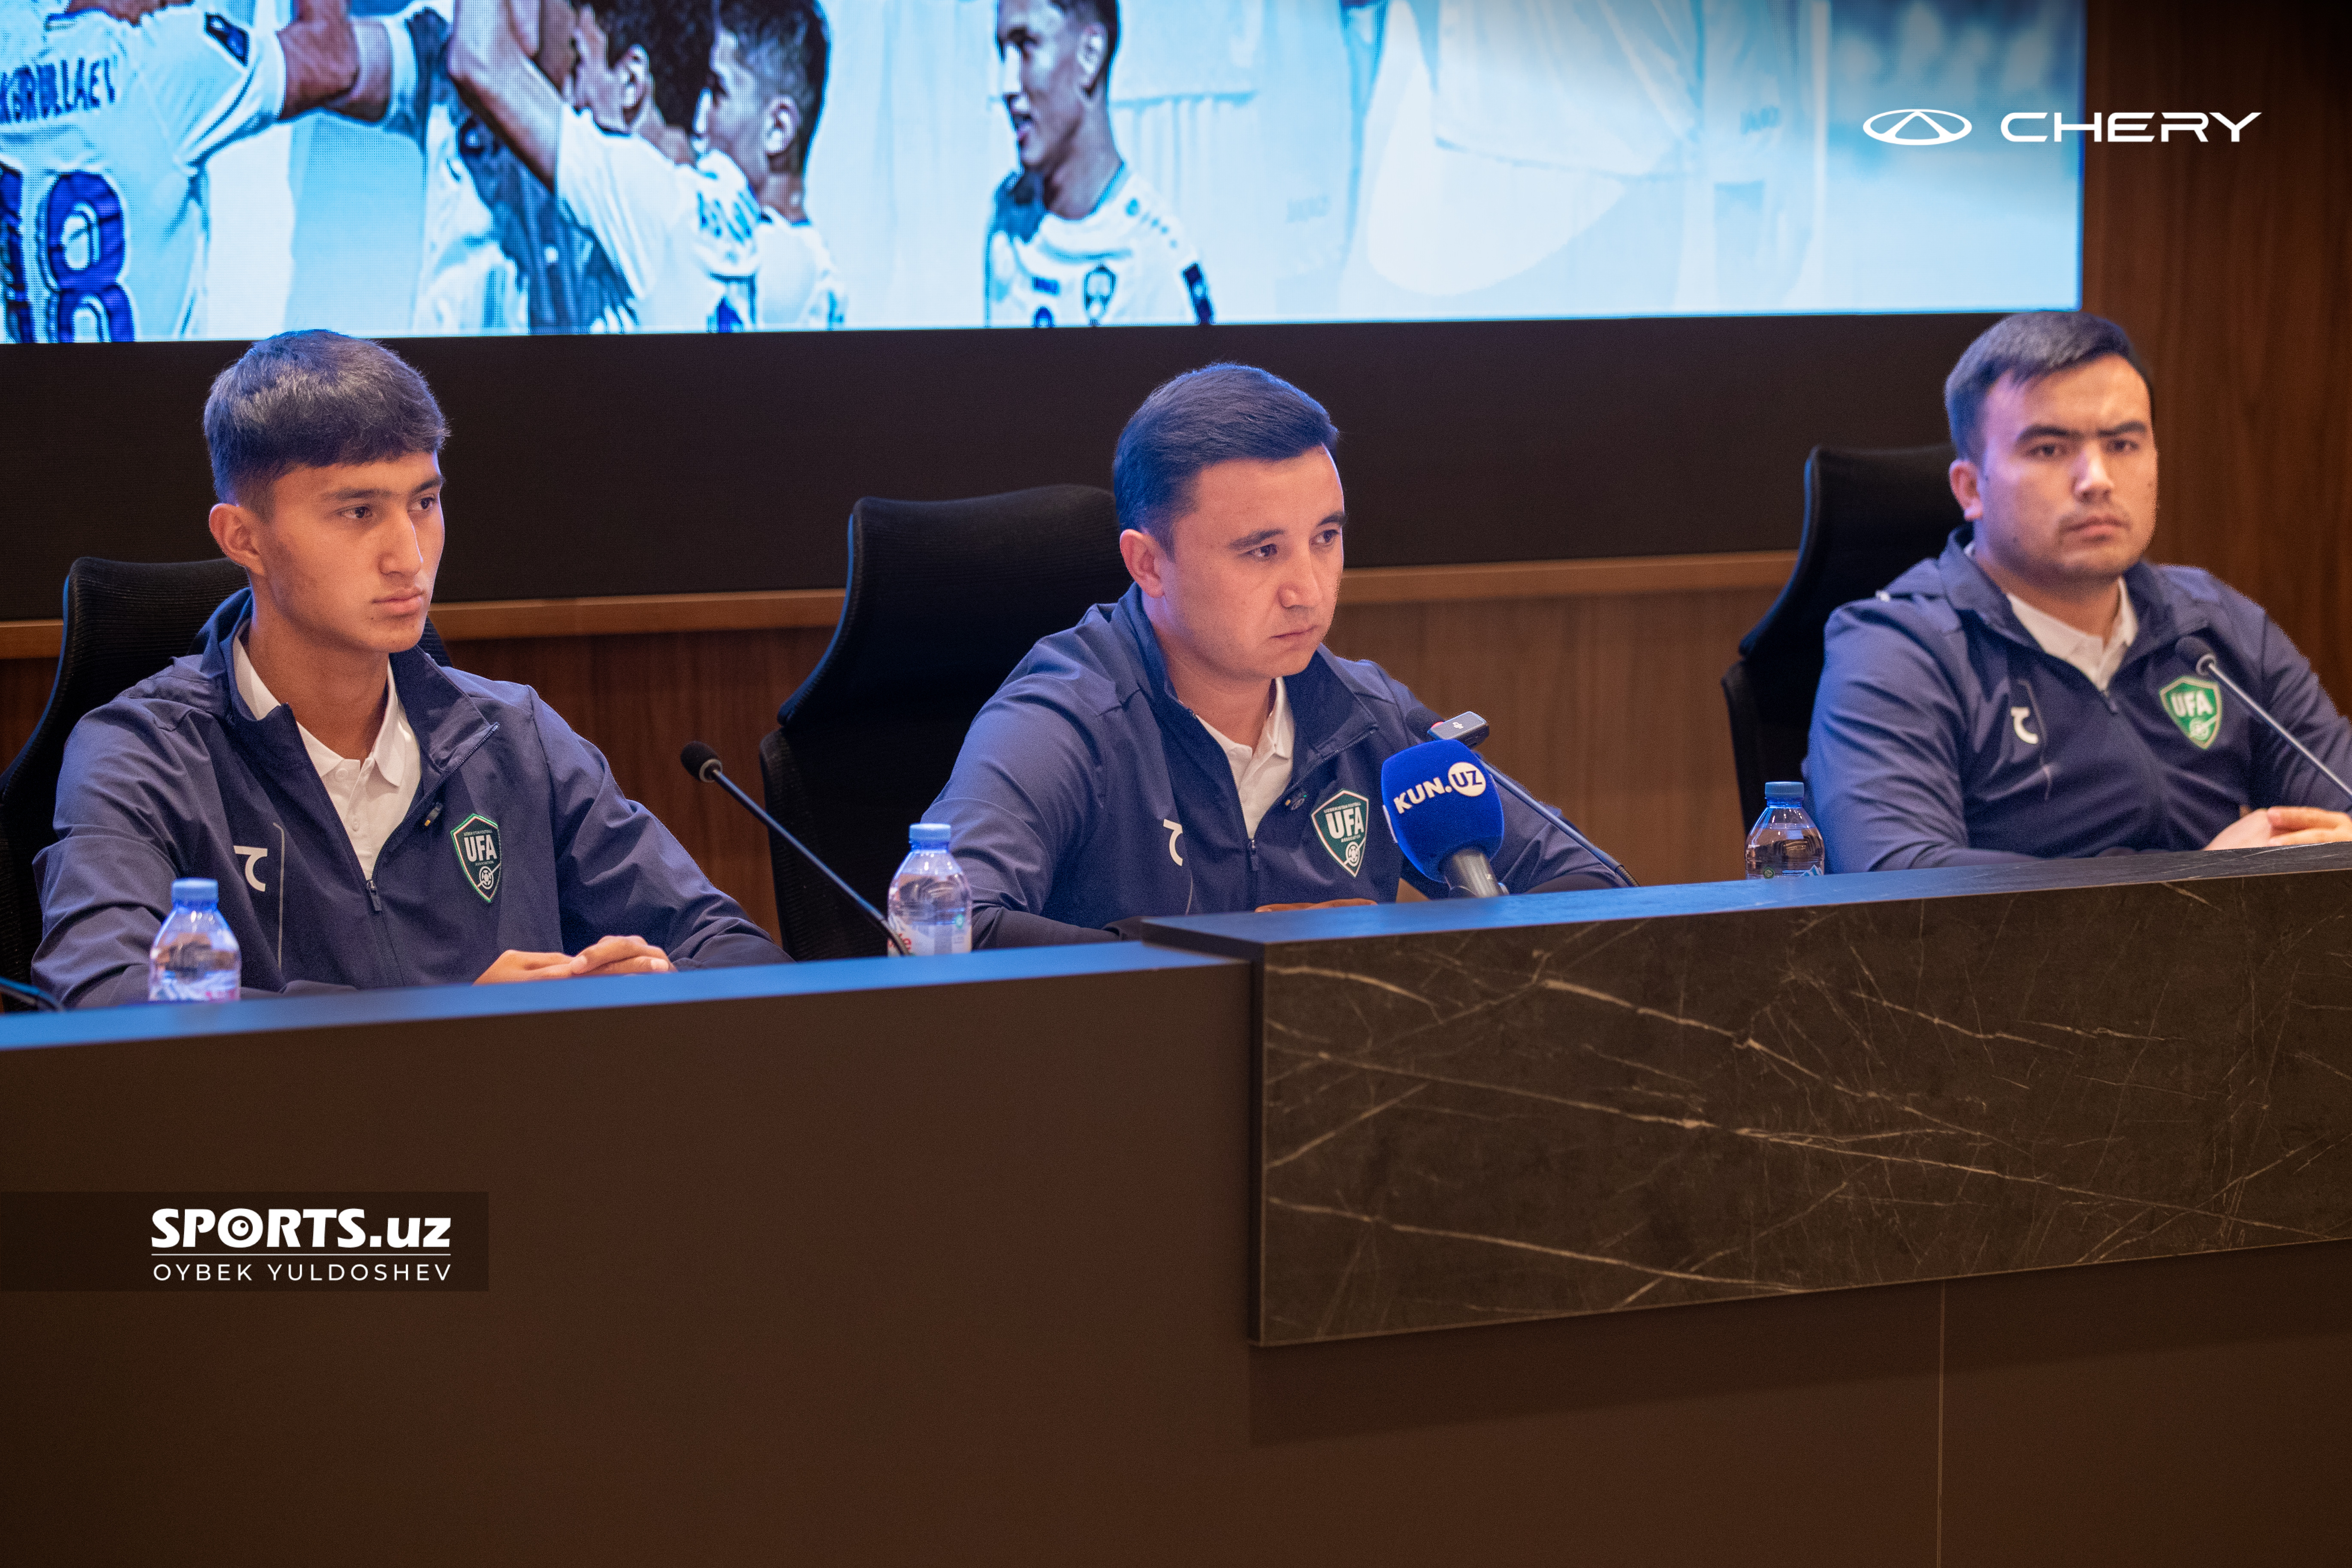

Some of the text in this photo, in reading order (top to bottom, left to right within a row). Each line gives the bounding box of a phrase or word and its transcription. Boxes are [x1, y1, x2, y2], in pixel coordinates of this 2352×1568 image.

[2171, 691, 2213, 717] UFA
[1394, 770, 1483, 814] KUN.UZ
[1325, 807, 1364, 839] UFA
[464, 834, 497, 862] UFA
